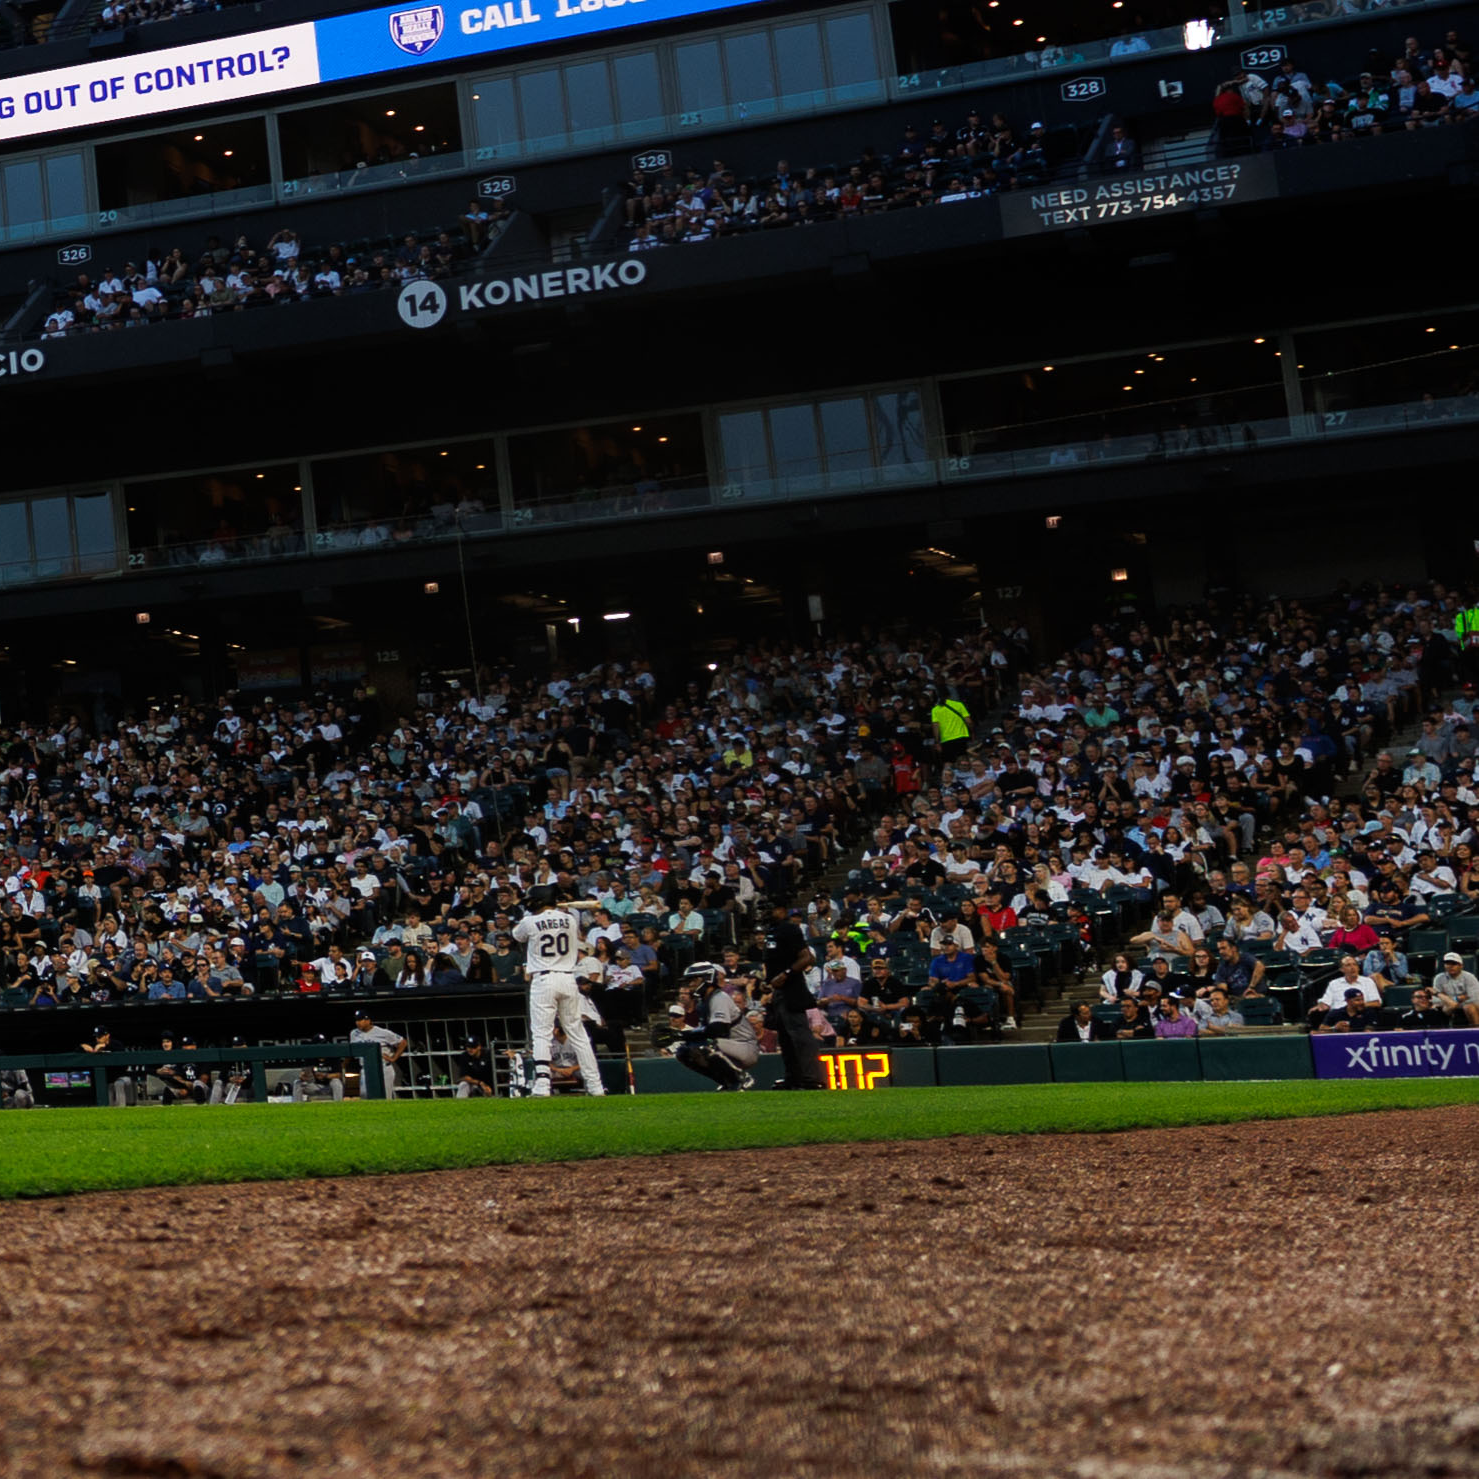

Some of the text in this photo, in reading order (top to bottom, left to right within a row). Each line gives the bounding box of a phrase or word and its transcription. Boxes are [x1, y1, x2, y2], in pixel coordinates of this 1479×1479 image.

[460, 0, 541, 35] CALL
[1265, 8, 1286, 24] 25
[1247, 48, 1281, 65] 329
[24, 85, 80, 115] OUT
[89, 76, 125, 103] OF
[134, 46, 291, 95] CONTROL?
[898, 74, 920, 88] 24
[1067, 82, 1099, 98] 328
[638, 153, 666, 168] 328
[283, 181, 298, 193] 21
[484, 179, 510, 194] 326
[1031, 164, 1241, 210] NEED ASSISTANCE?
[1040, 184, 1237, 226] TEXT 773-754-4357
[99, 210, 118, 222] 20
[62, 248, 87, 262] 326
[405, 259, 646, 317] 14 KONERKO
[1324, 412, 1346, 426] 27
[949, 457, 969, 470] 26
[129, 553, 145, 565] 22
[376, 650, 399, 663] 125
[535, 919, 570, 931] VARGAS
[540, 933, 570, 957] 20
[1345, 1037, 1456, 1072] xfinity
